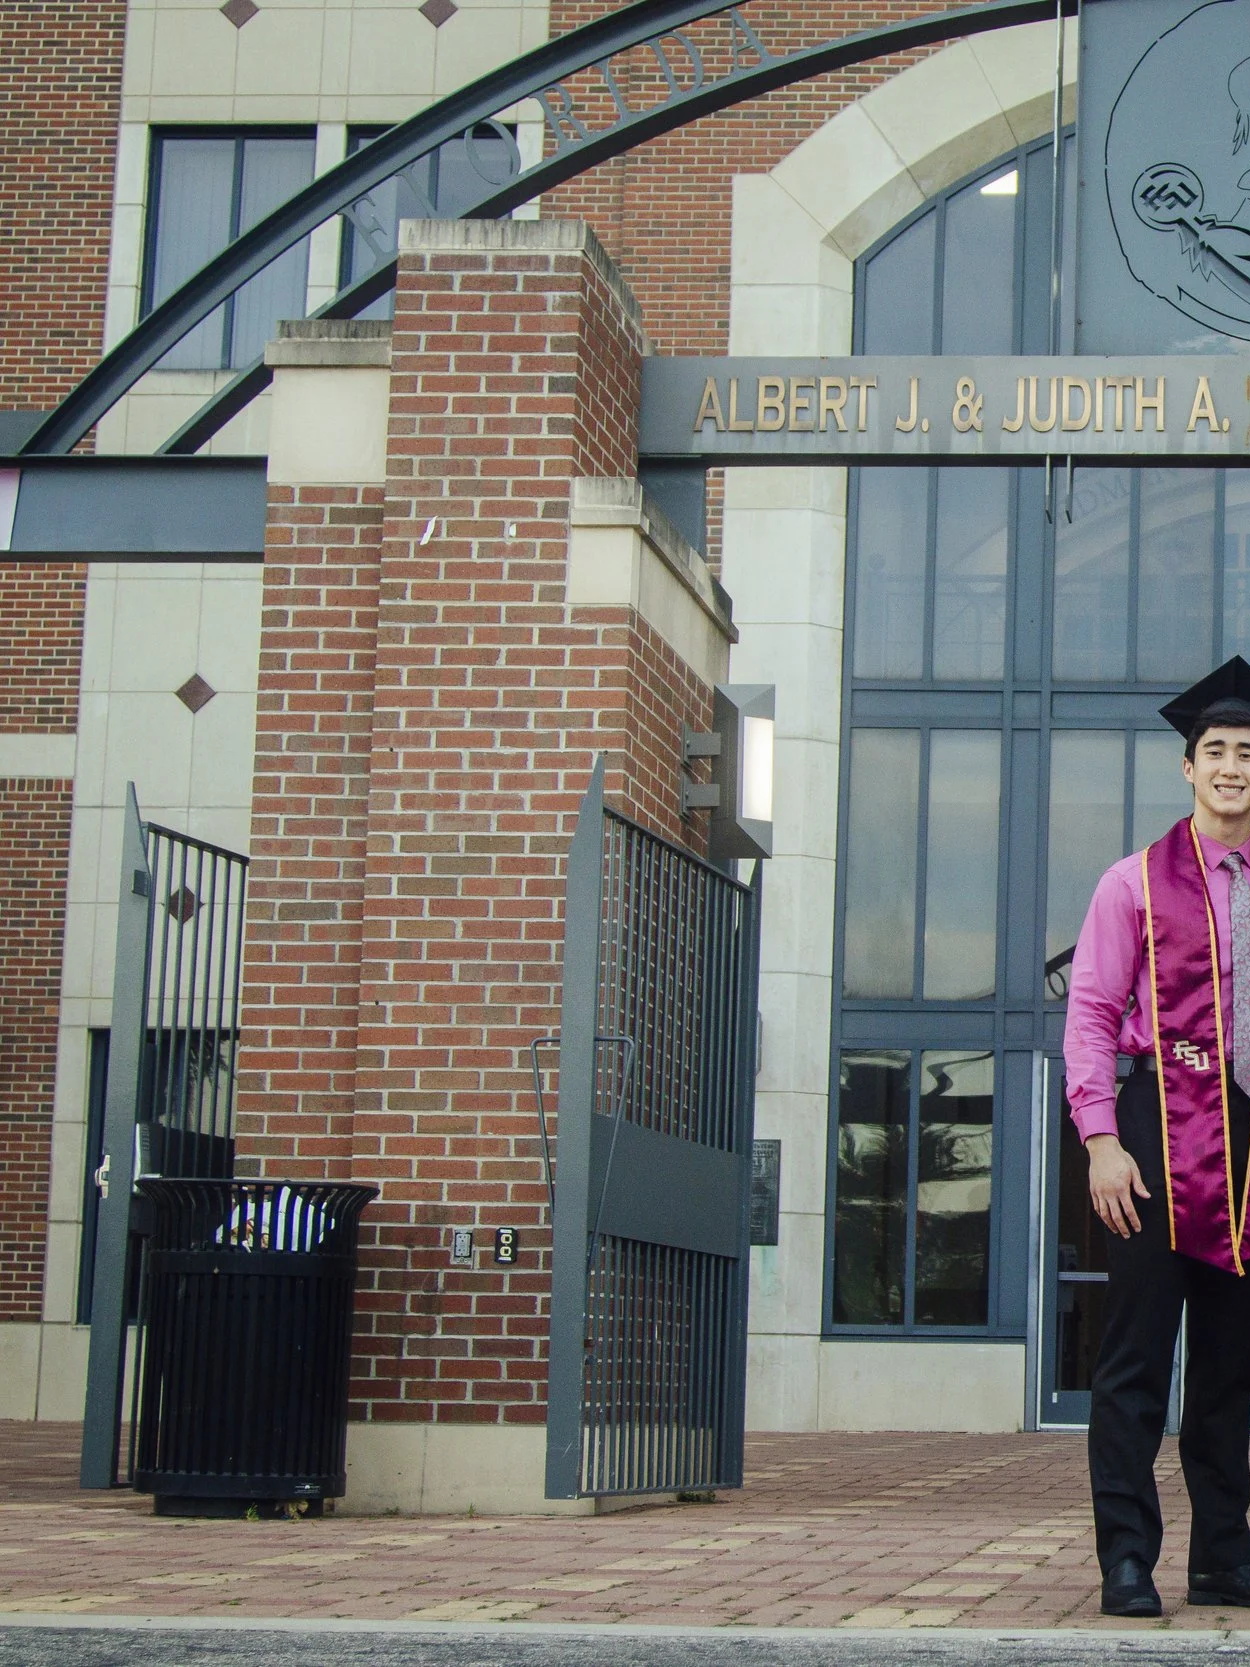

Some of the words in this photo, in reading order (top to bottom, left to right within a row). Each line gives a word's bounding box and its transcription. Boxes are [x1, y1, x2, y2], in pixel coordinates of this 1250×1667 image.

[693, 375, 879, 434] ALBERT
[895, 376, 930, 434] J.
[952, 375, 984, 434] &
[1001, 376, 1166, 434] JUDITH
[1186, 376, 1230, 434] A.
[1172, 1040, 1210, 1072] FSU
